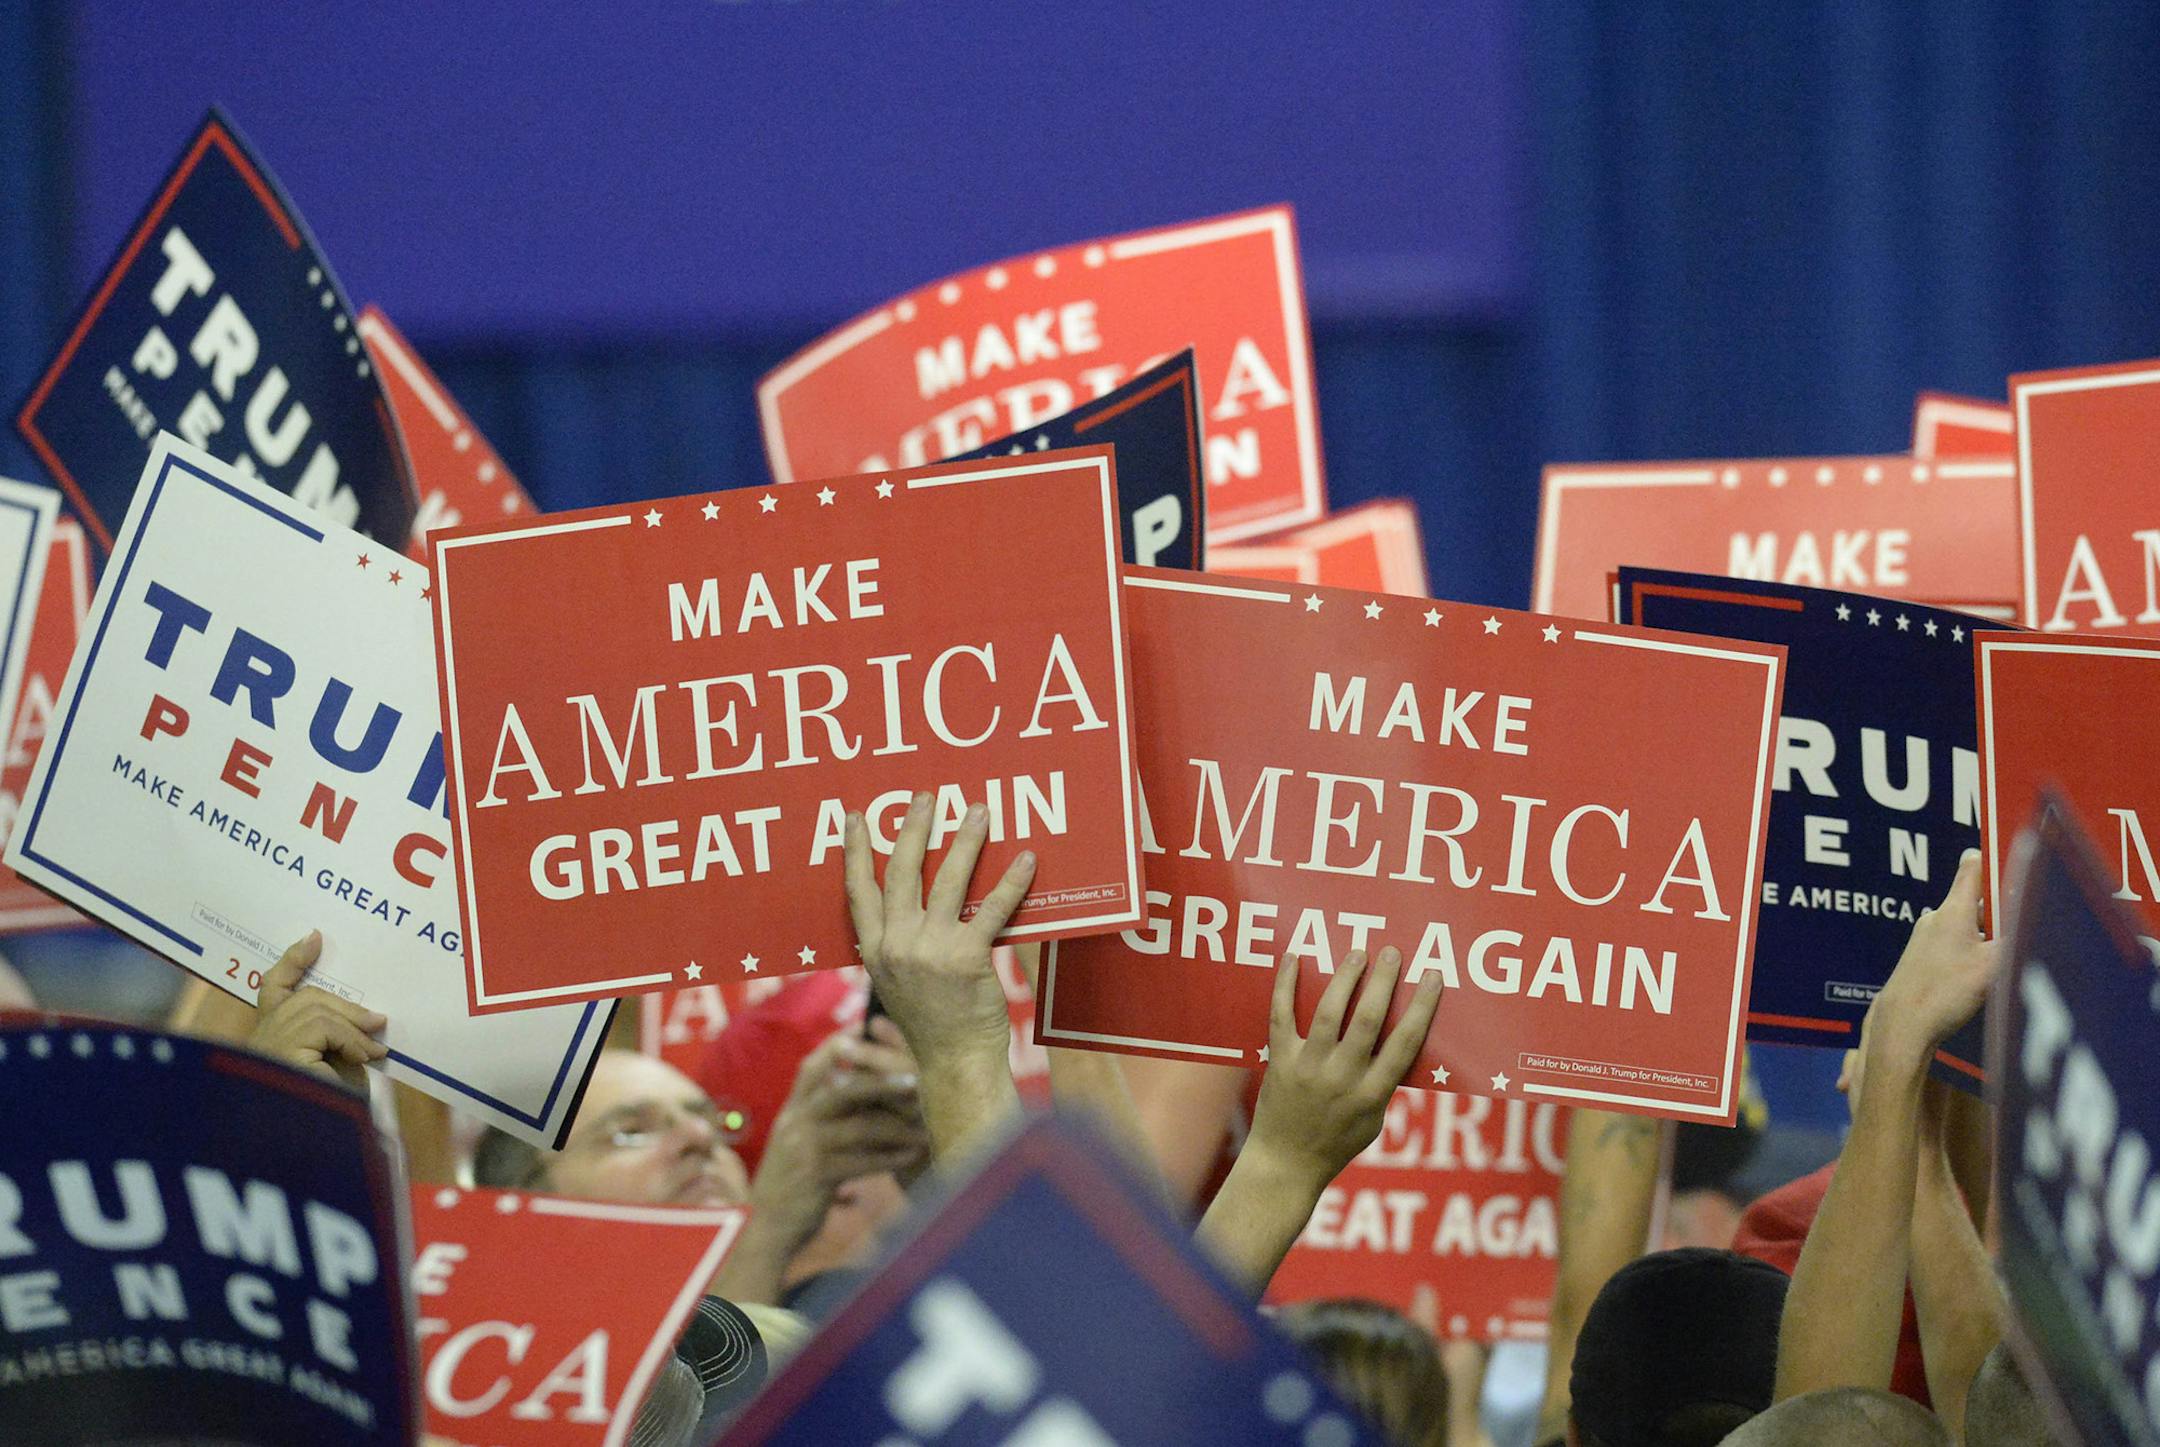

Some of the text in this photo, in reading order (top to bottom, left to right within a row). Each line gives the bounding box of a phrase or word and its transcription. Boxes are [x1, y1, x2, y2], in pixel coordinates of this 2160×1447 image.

[150, 224, 372, 537] TRUM
[913, 299, 1101, 399] MAKE
[668, 557, 886, 642] MAKE
[1727, 529, 1911, 586] MAKE
[475, 632, 1110, 809] AMERICA
[1308, 671, 1532, 757] MAKE
[112, 753, 464, 958] MAKE AMERICA GREAT AG
[528, 768, 1069, 902] GREAT AGAIN
[1102, 888, 1117, 898] Inc.
[1788, 884, 1914, 924] AMERICA
[1120, 890, 1678, 1016] GREAT AGAIN
[1527, 1057, 1545, 1067] Paid
[1546, 1058, 1559, 1069] for
[1560, 1060, 1571, 1071] by
[1571, 1063, 1601, 1074] Donald
[1610, 1067, 1637, 1080] Trump
[1638, 1070, 1651, 1080] for
[1652, 1072, 1693, 1087] President,
[1695, 1076, 1710, 1088] Inc.
